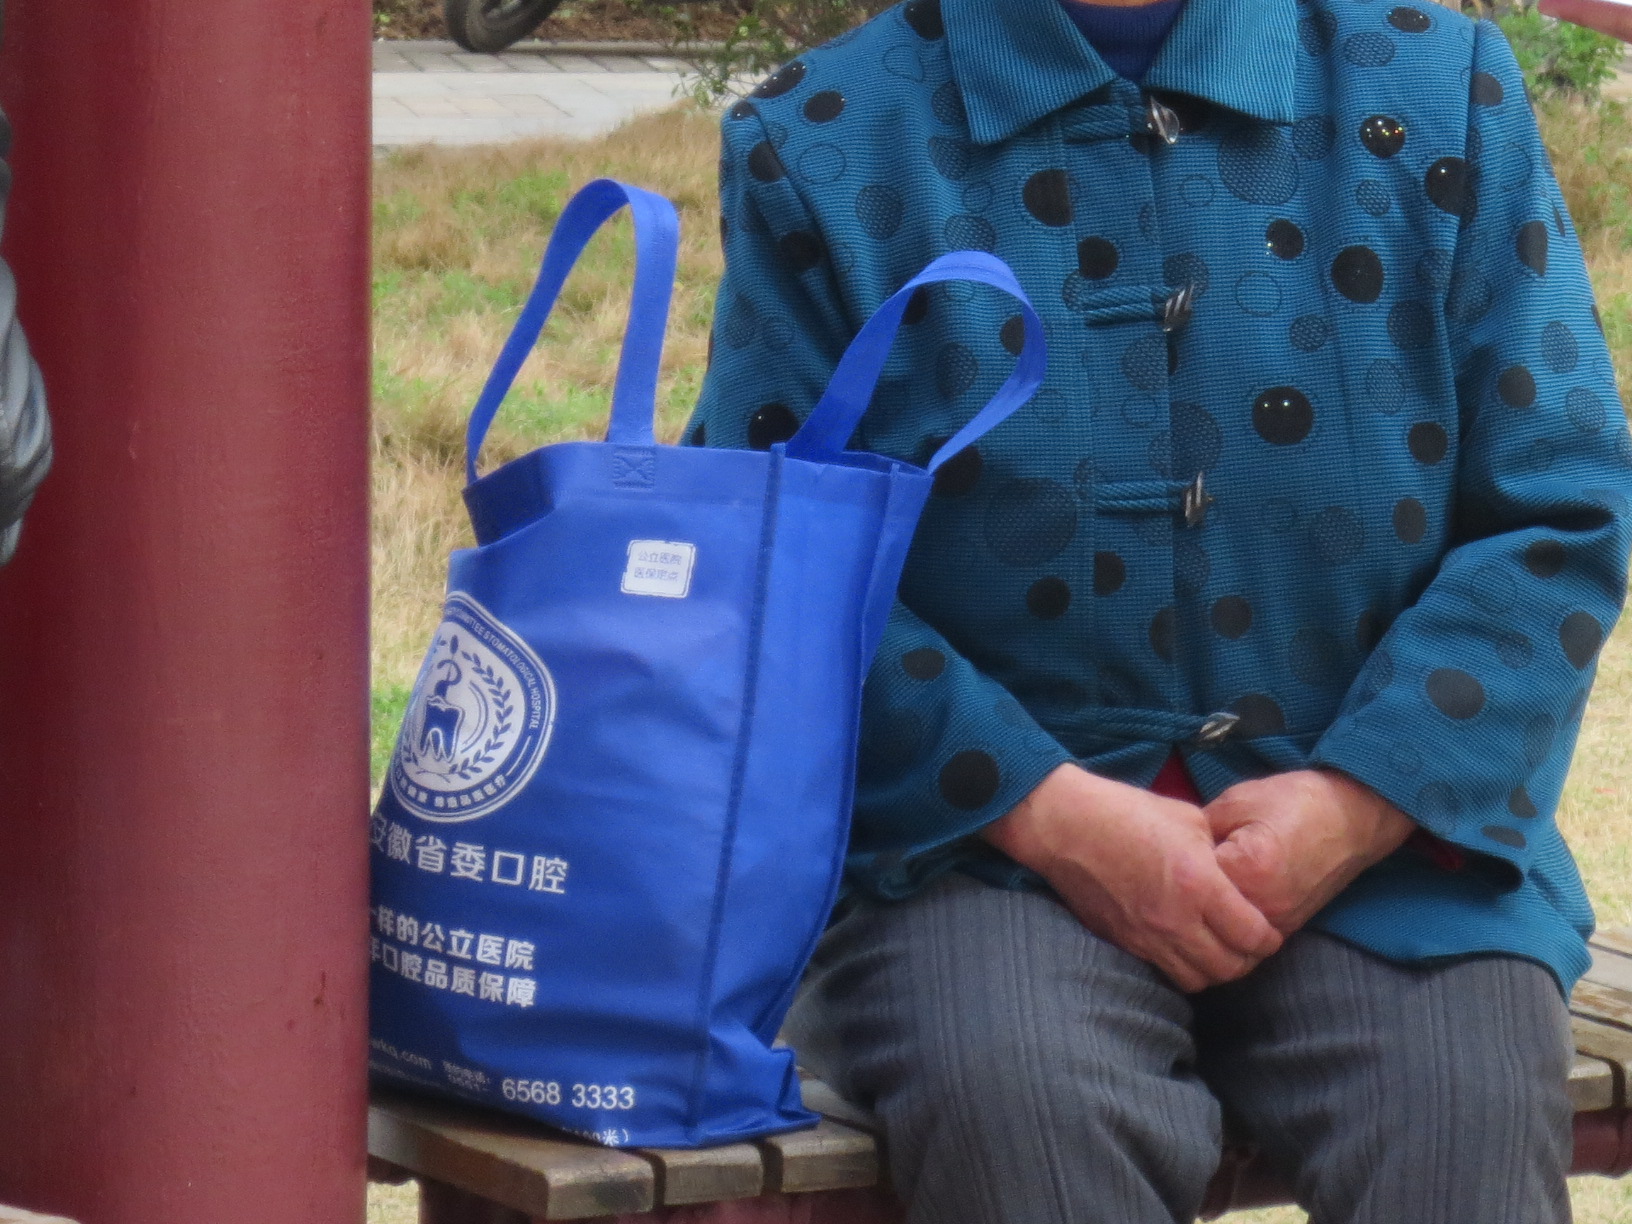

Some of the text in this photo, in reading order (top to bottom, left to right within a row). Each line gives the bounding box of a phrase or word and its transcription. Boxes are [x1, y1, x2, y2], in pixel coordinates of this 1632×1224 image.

[528, 686, 542, 730] HOSPITAL
[502, 1078, 635, 1110] 6568 3333
